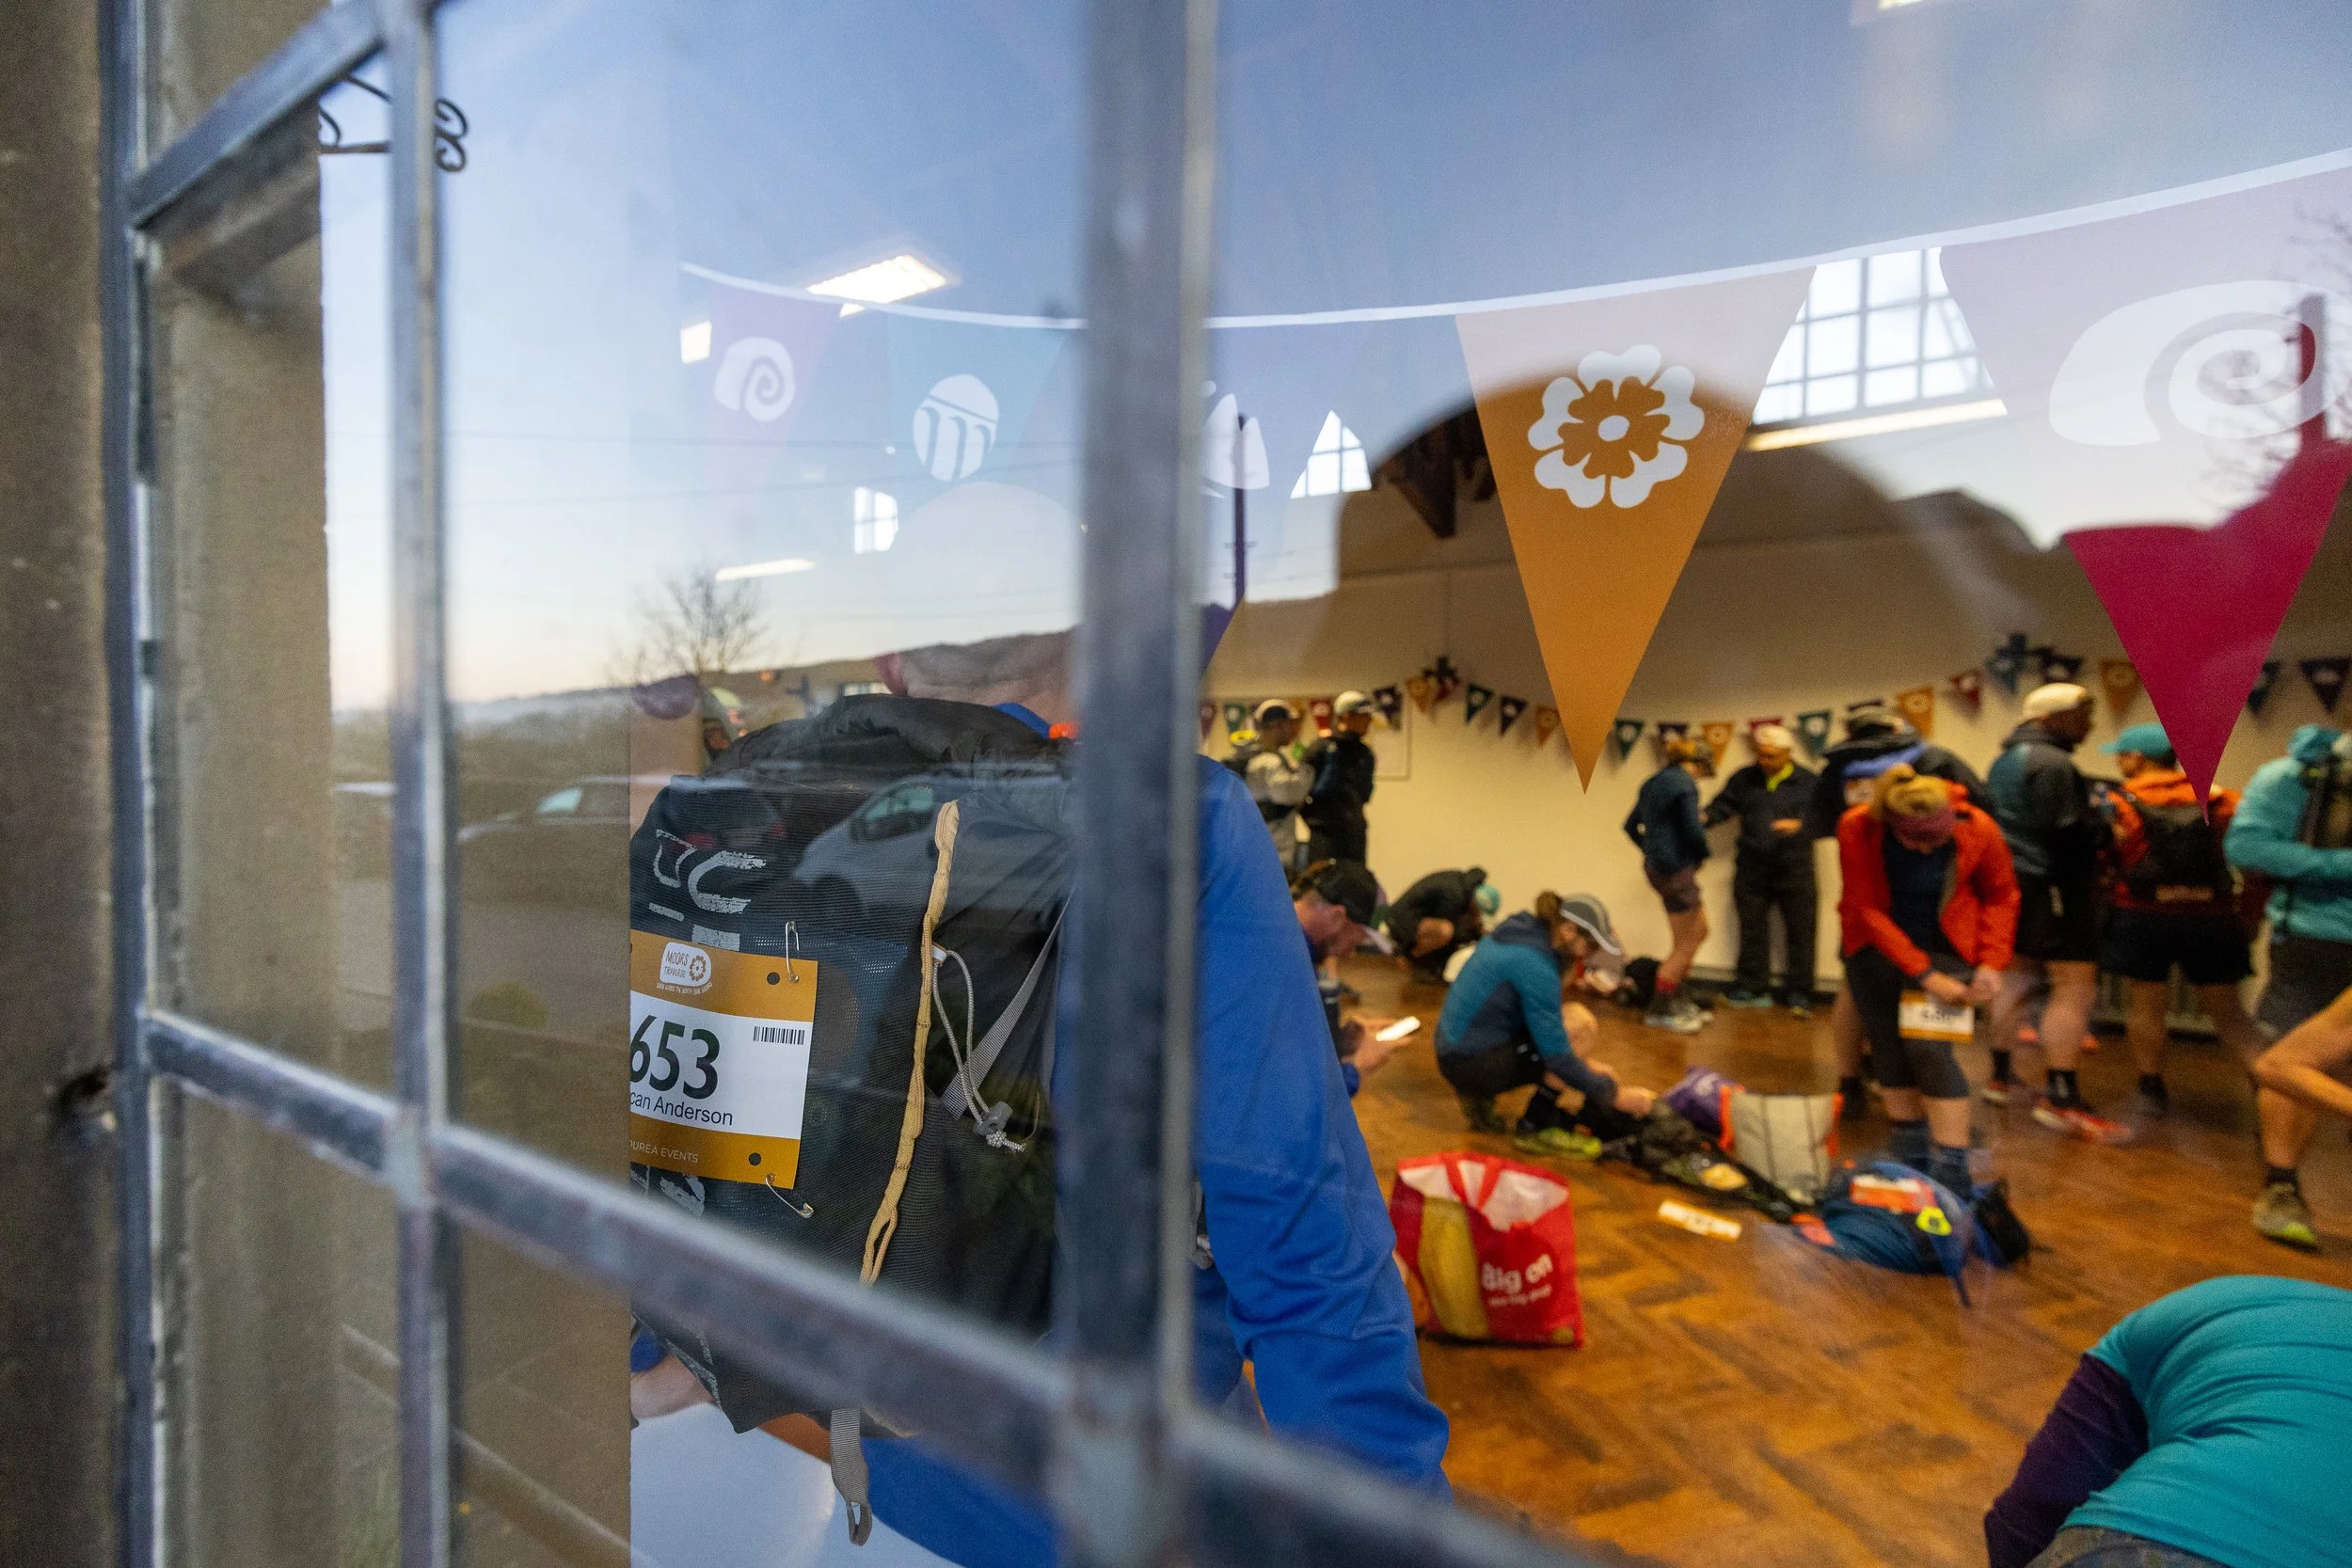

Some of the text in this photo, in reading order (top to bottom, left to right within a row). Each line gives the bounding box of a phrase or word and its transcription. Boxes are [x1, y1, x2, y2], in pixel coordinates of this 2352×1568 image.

[666, 950, 689, 966] MOORS
[630, 1015, 720, 1100] 653
[653, 1096, 733, 1126] Anderson
[660, 1148, 699, 1164] EVENTS
